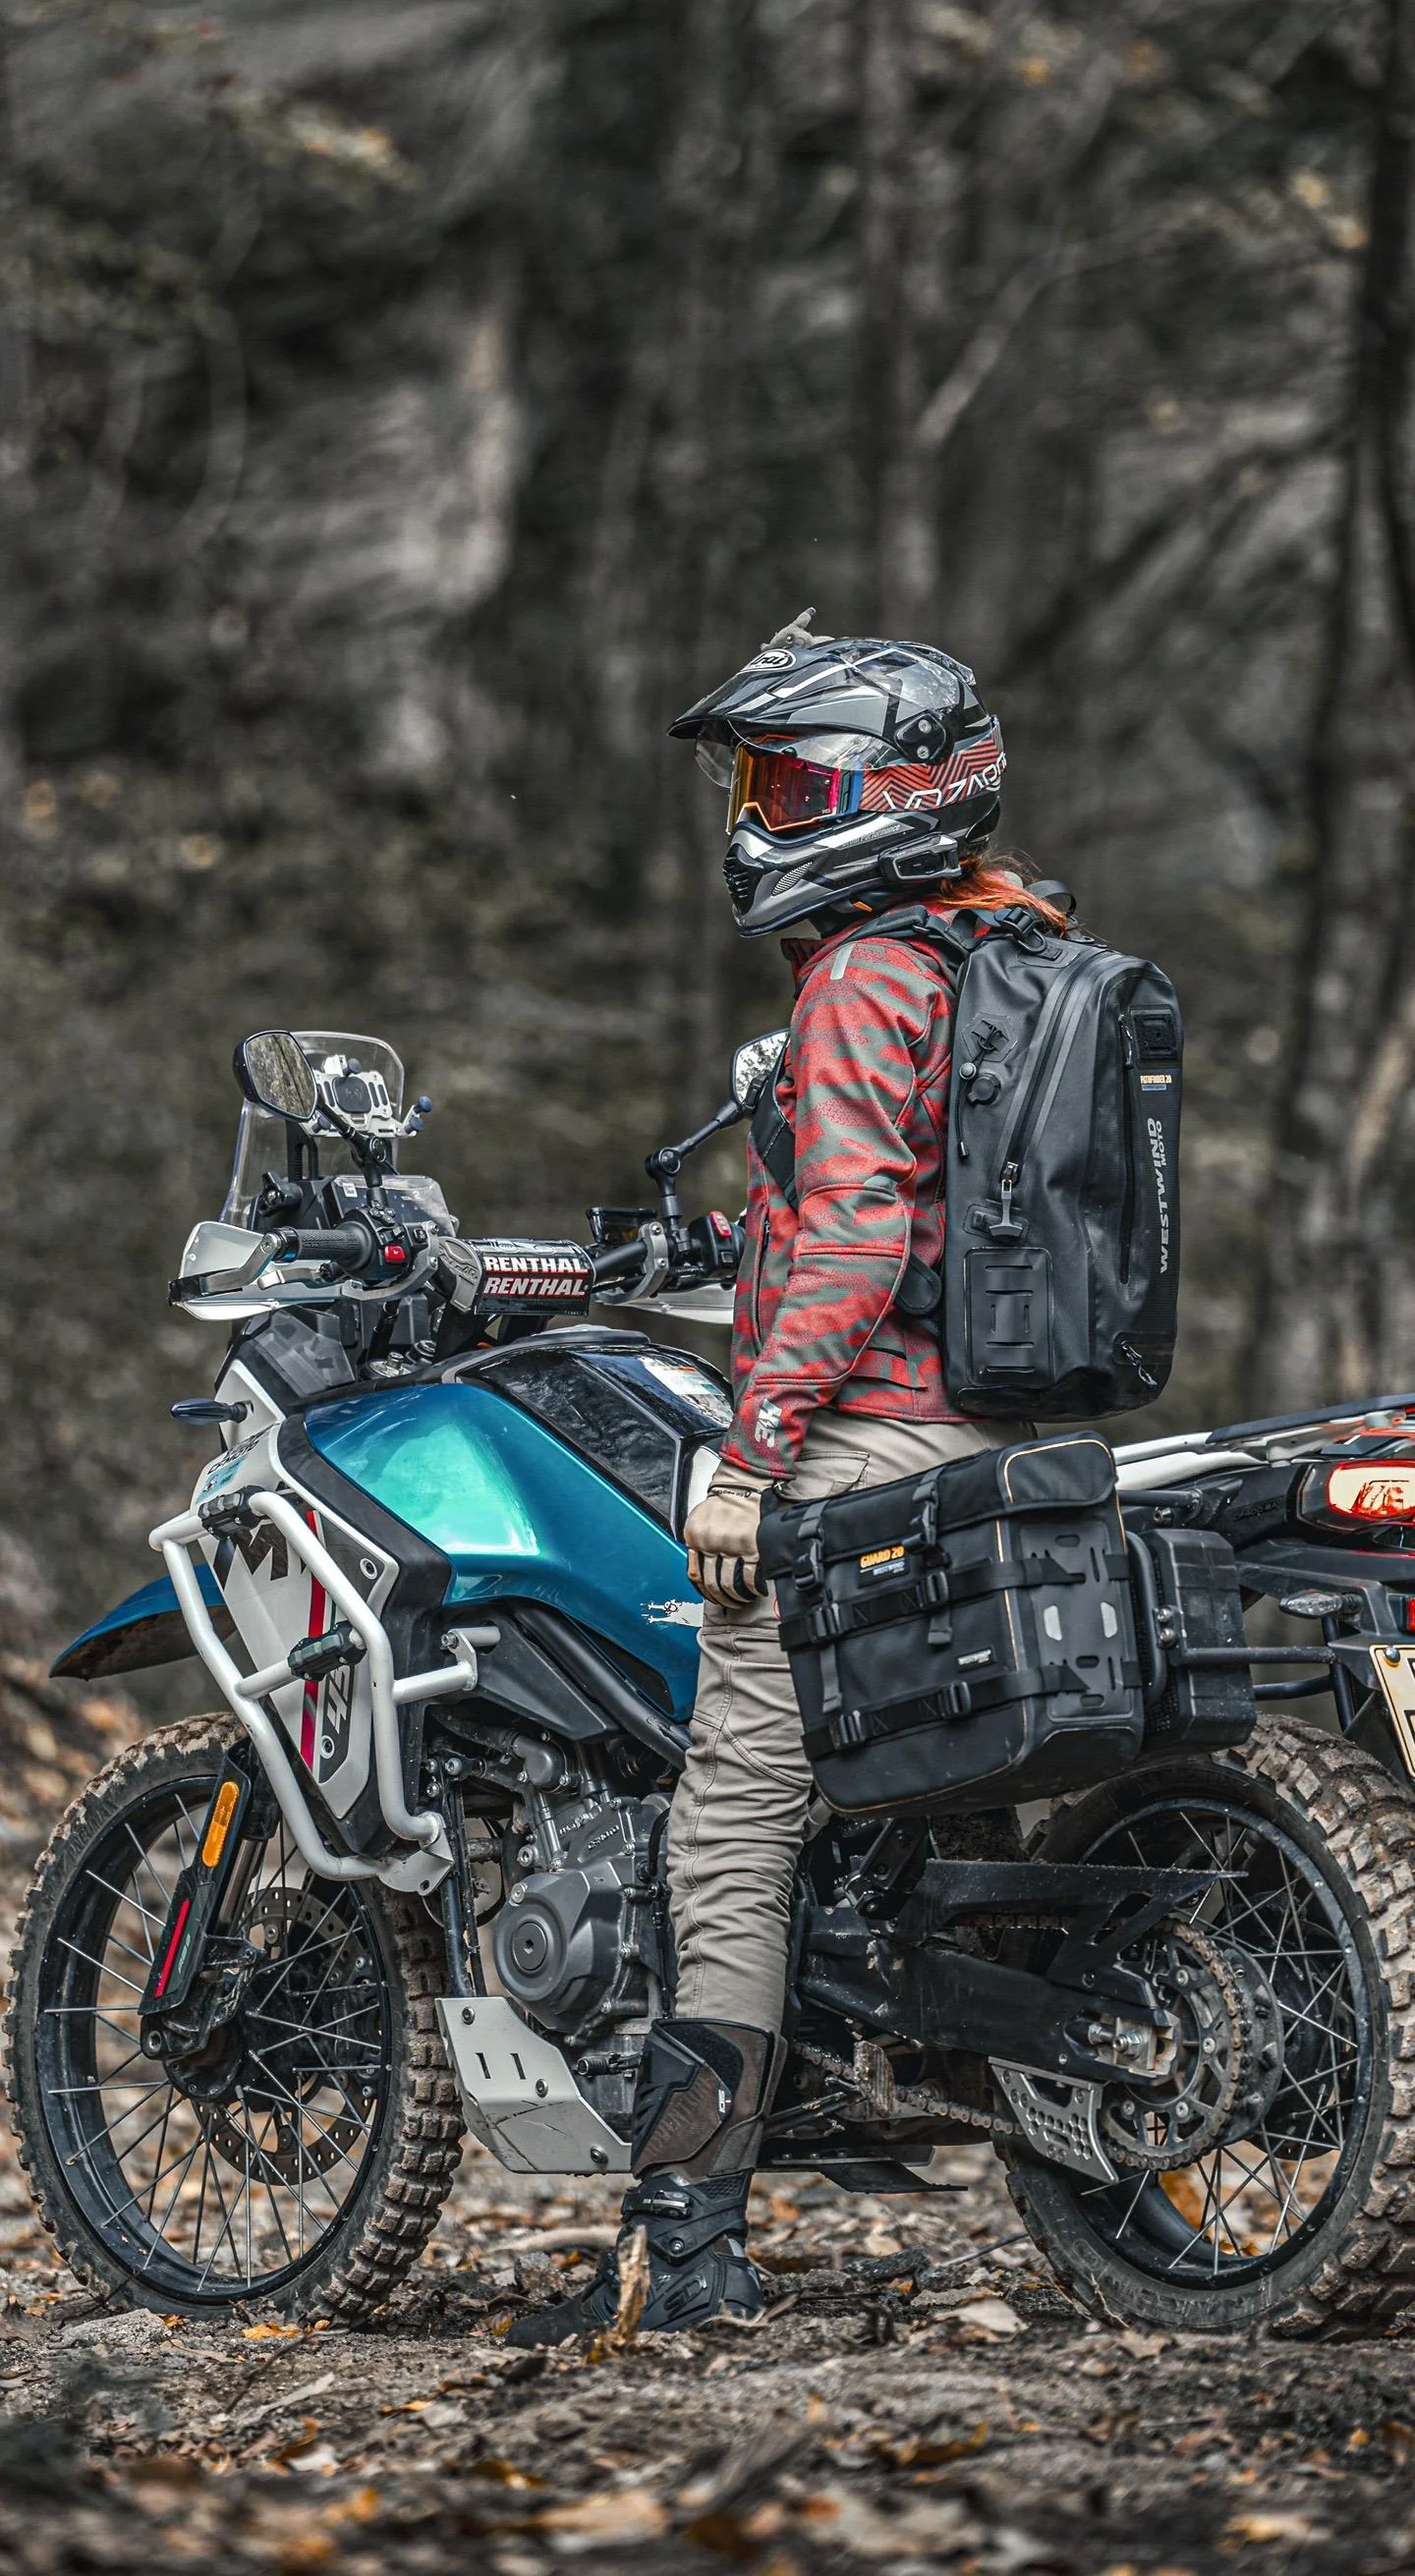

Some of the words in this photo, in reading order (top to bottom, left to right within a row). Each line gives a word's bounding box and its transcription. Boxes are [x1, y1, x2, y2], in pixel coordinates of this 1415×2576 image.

[1156, 1120, 1167, 1166] MOTO
[1148, 1117, 1169, 1274] WESTWIND
[482, 1257, 589, 1273] RENTHAL
[483, 1278, 587, 1296] RENTHAL
[861, 1549, 890, 1568] GUARD
[891, 1545, 904, 1559] 20
